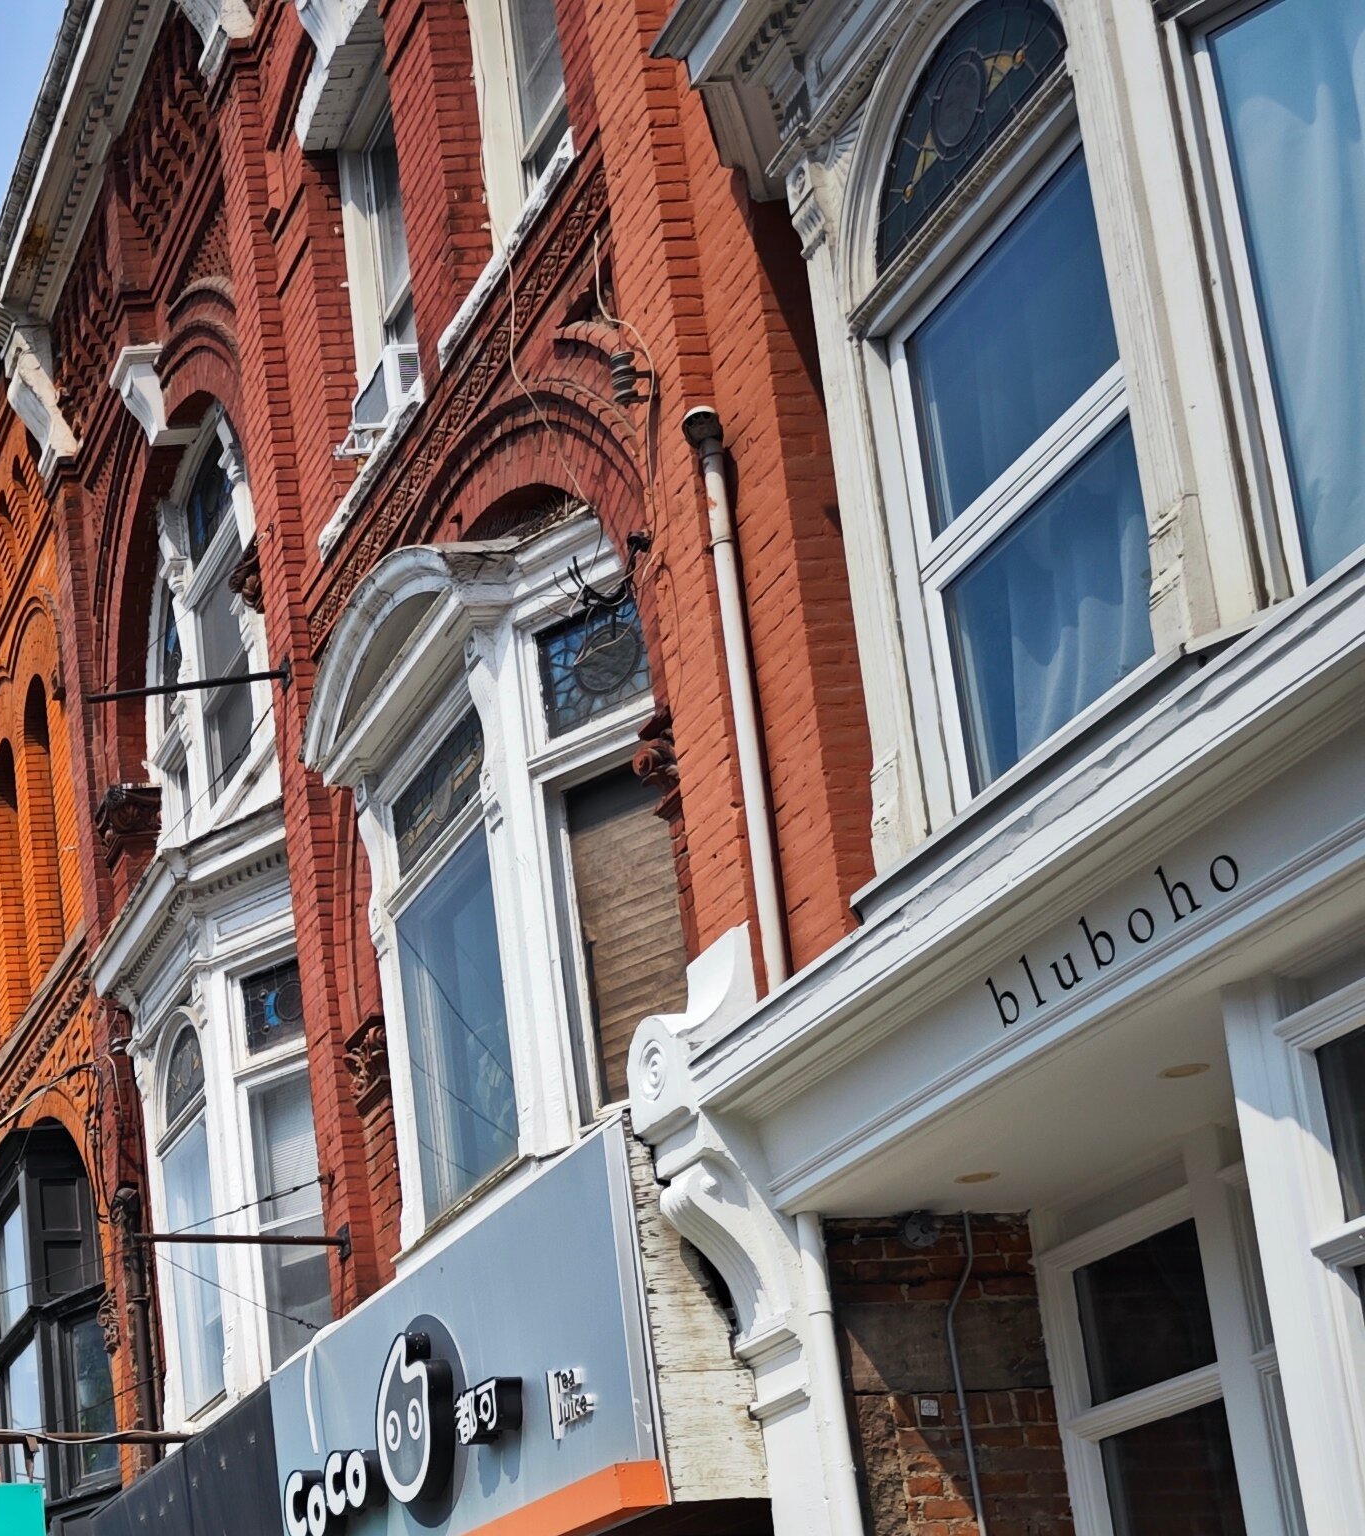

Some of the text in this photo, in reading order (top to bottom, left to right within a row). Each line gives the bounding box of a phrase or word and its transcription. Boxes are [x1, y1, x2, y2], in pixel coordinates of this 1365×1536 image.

[984, 853, 1240, 1029] bluboho
[554, 1369, 576, 1394] Tea
[454, 1378, 498, 1446] 都可
[558, 1394, 588, 1426] Juice
